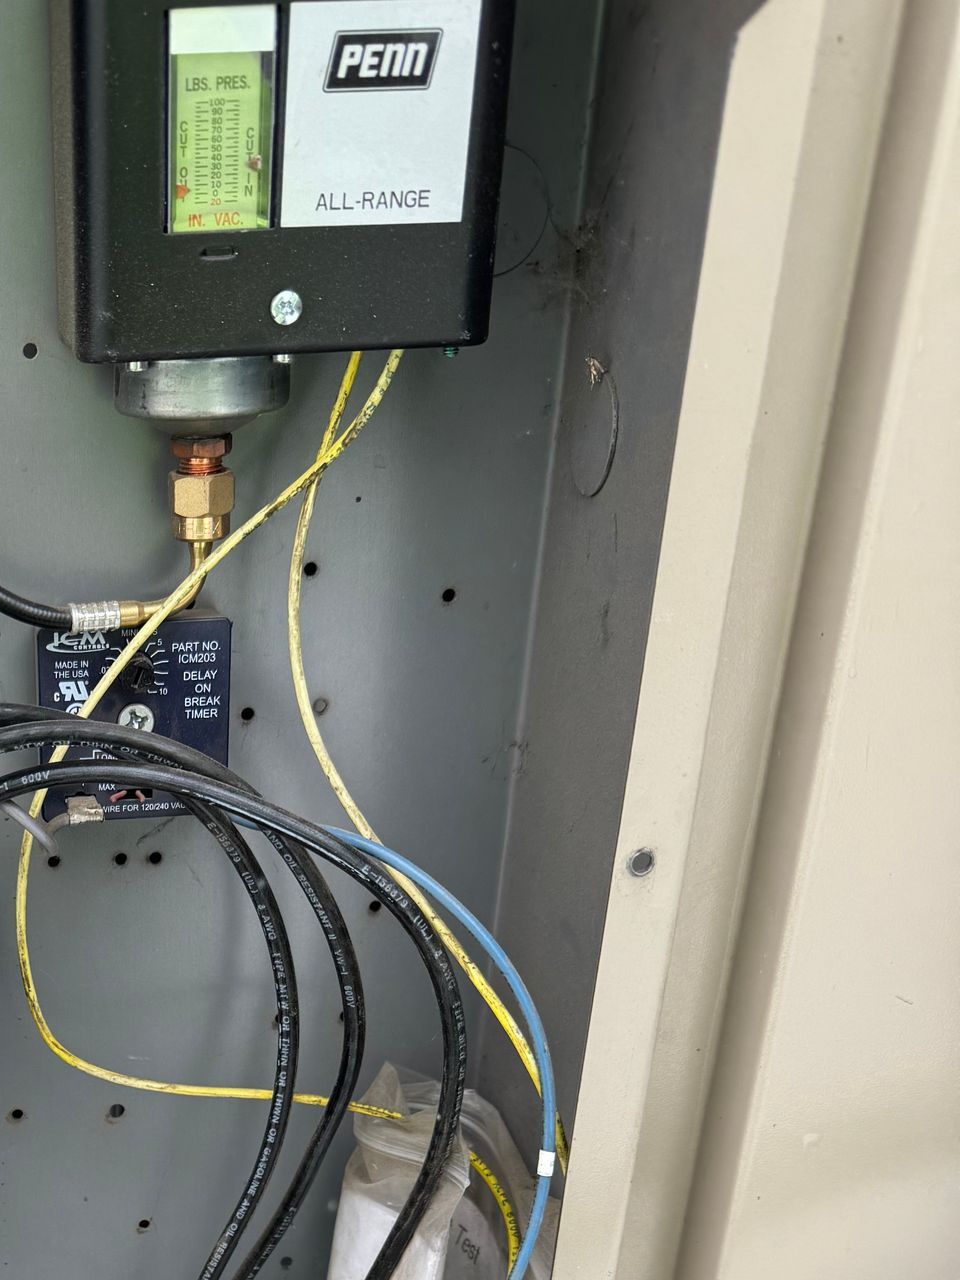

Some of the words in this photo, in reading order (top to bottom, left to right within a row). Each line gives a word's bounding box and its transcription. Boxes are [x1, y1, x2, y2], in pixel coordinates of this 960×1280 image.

[186, 78, 211, 91] LBS.
[216, 75, 250, 90] PRES.
[315, 189, 431, 211] ALL-RANGE
[188, 214, 206, 228] IN.
[214, 211, 244, 226] VAC.
[171, 642, 199, 652] PART
[202, 641, 221, 650] NO.
[55, 661, 78, 669] MADE
[81, 660, 89, 668] IN
[178, 653, 216, 663] ICM203
[54, 671, 70, 679] THE
[72, 670, 89, 678] USA
[183, 670, 217, 680] DELAY
[195, 683, 211, 693] ON
[185, 696, 220, 707] BREAK
[185, 709, 218, 719] TIMER
[21, 770, 51, 785] 600V
[98, 783, 116, 791] MAX
[102, 804, 120, 813] WIRE
[122, 804, 139, 812] FOR
[261, 915, 277, 941] AWG
[284, 853, 298, 870] OIL
[298, 874, 333, 929] RESISTANT
[343, 985, 356, 1008] 600V
[271, 1093, 284, 1124] THWN
[267, 1127, 277, 1143] OR
[247, 1147, 272, 1197] GASOLINE
[236, 1198, 250, 1220] AND
[225, 1222, 238, 1237] OIL
[455, 1223, 481, 1265] Test
